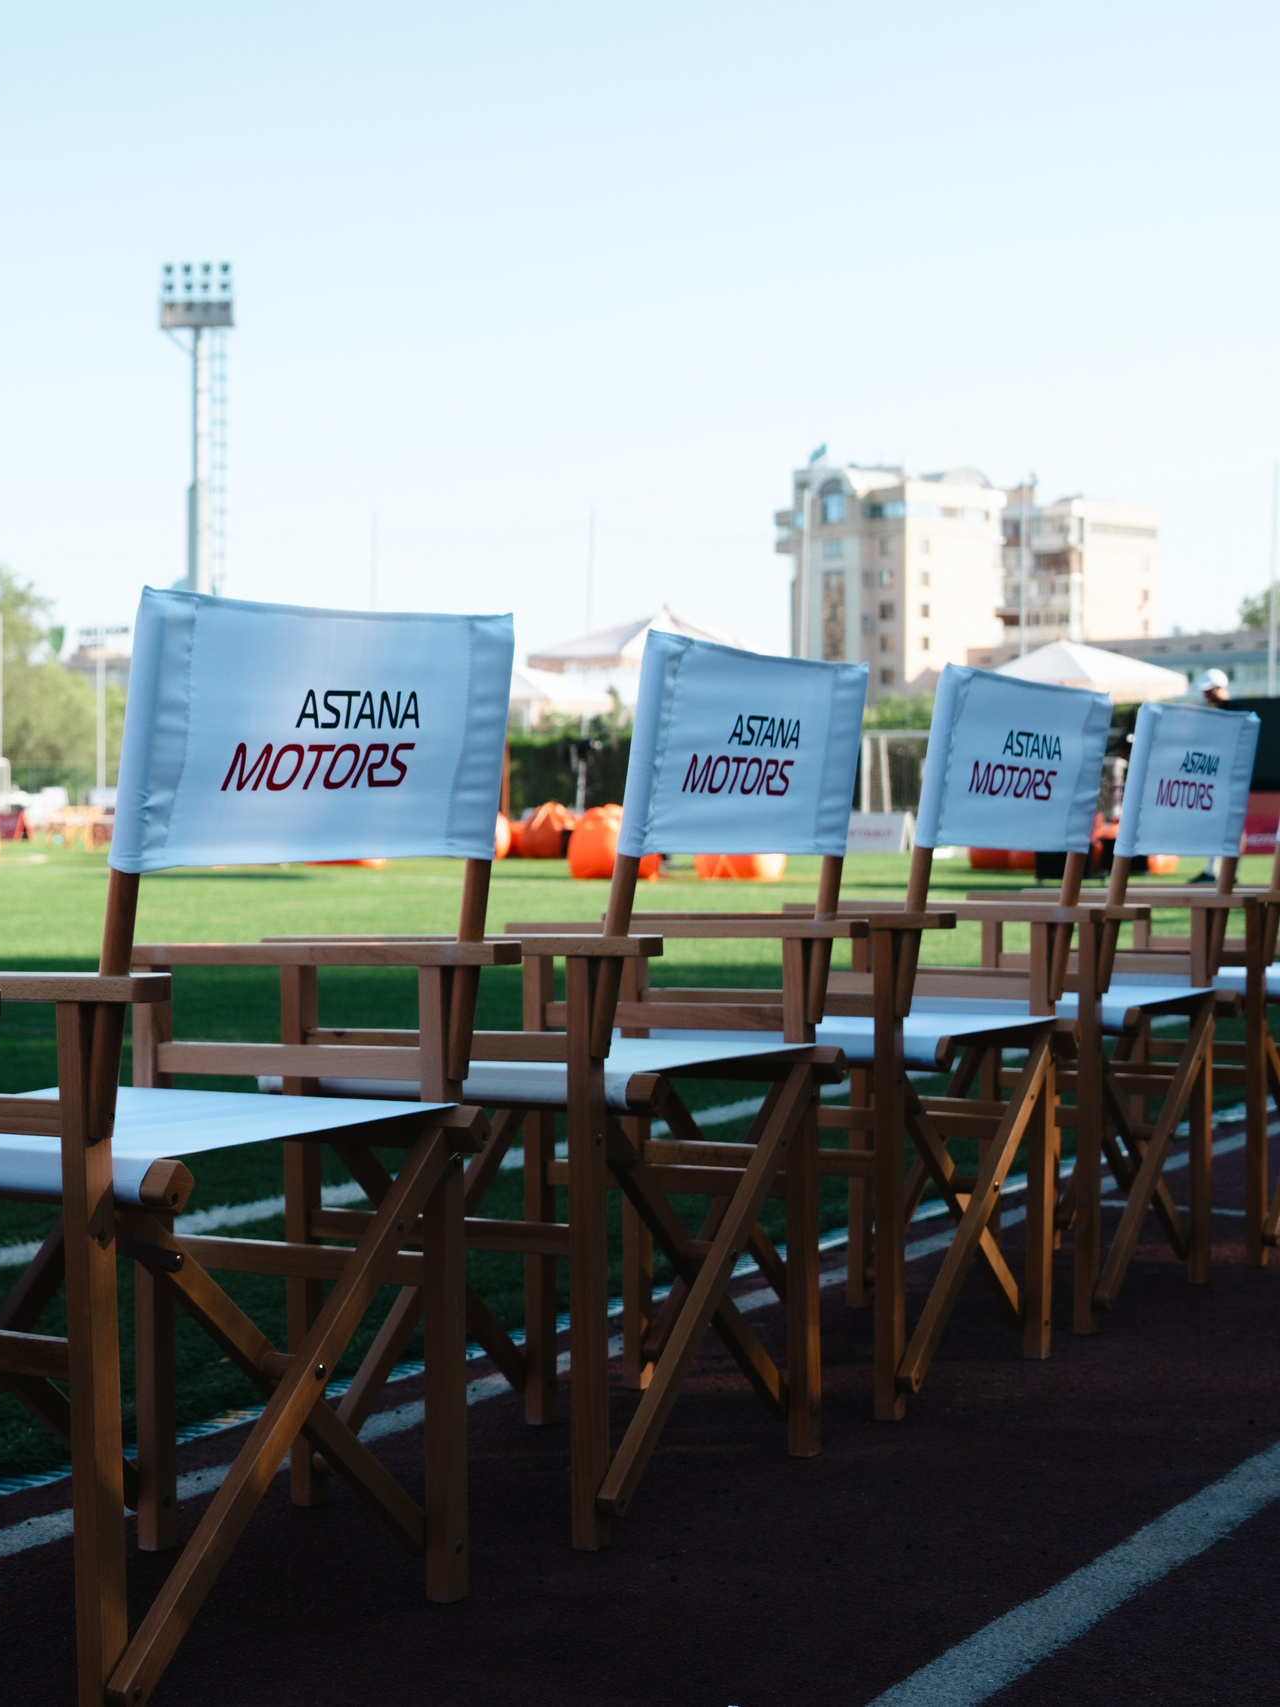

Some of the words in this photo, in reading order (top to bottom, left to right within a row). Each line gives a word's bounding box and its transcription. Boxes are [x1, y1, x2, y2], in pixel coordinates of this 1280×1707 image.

[295, 689, 420, 729] ASTANA
[727, 714, 800, 750] ASTANA
[1002, 730, 1062, 761] ASTANA
[220, 742, 416, 791] MOTORS
[681, 753, 795, 796] MOTORS
[968, 760, 1058, 801] MOTORS
[1179, 751, 1220, 777] ASTANA
[1155, 778, 1214, 811] MOTORS
